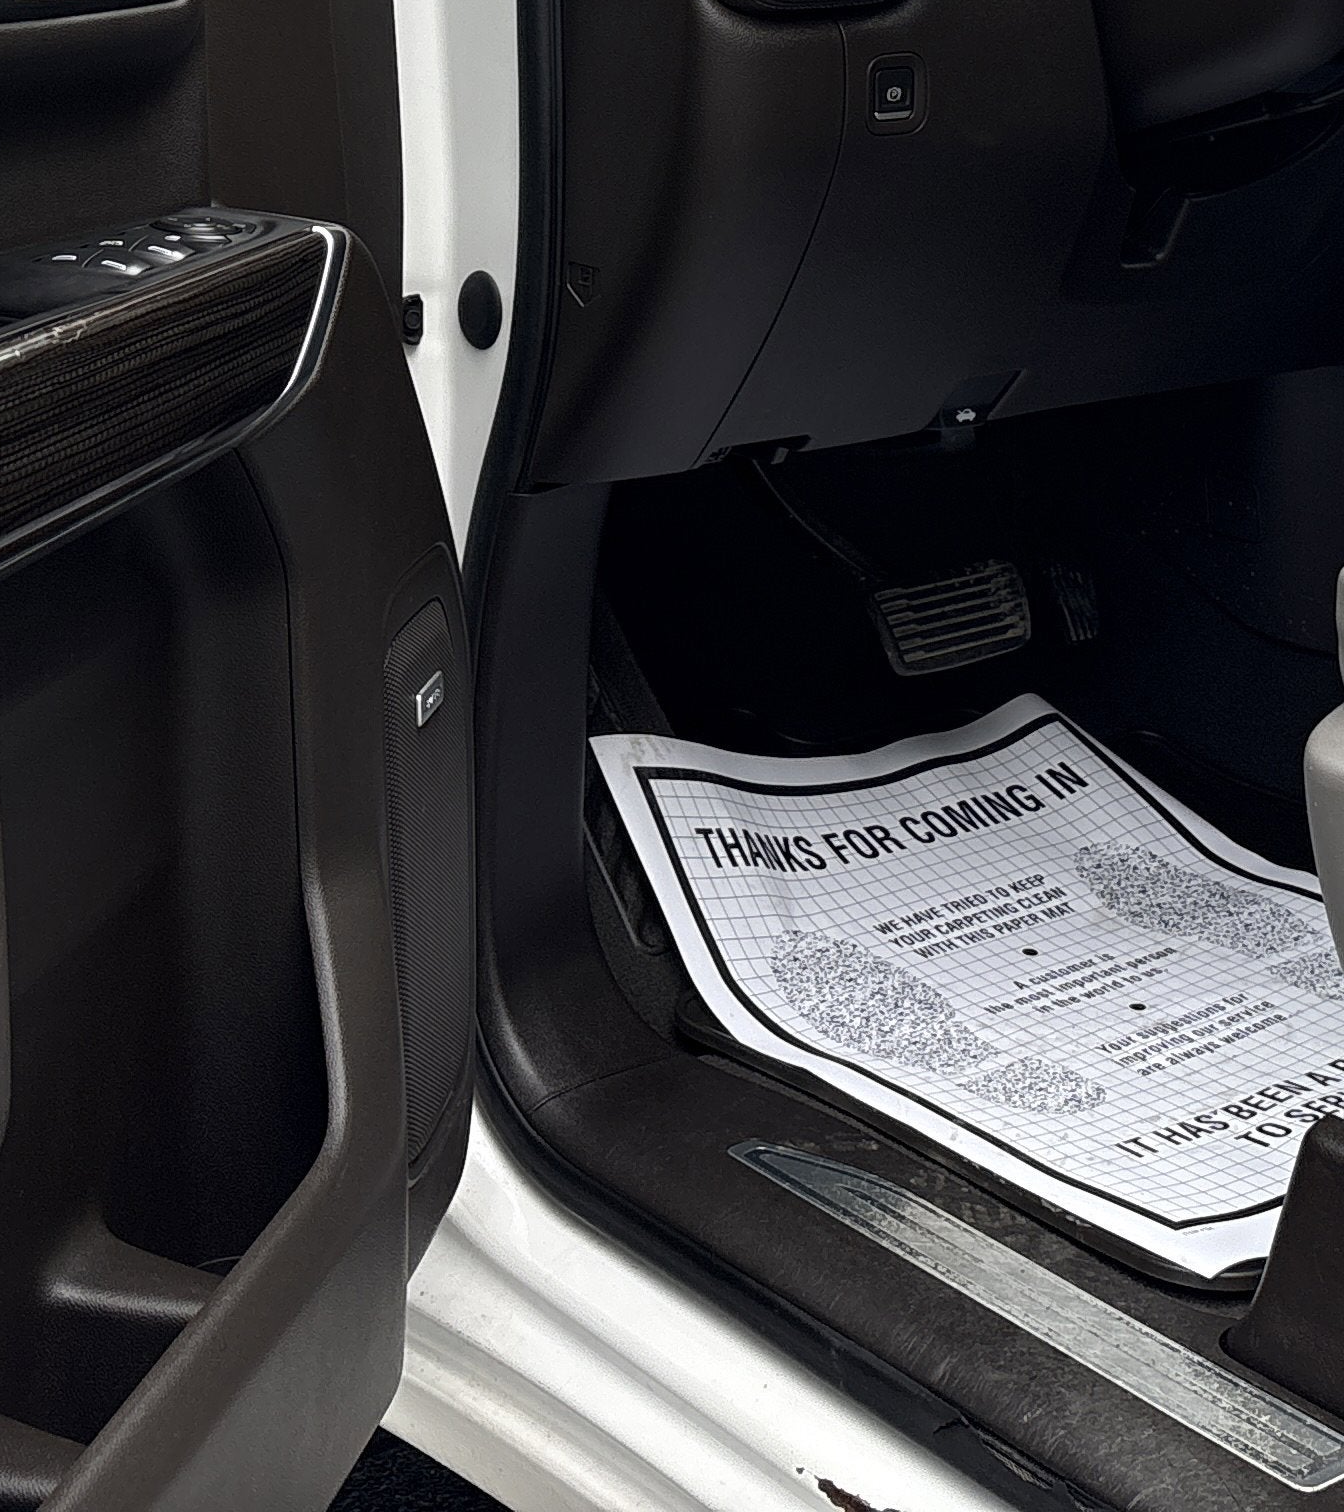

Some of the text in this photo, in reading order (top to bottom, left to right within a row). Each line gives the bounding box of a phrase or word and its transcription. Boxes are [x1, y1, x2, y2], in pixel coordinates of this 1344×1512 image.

[695, 761, 1090, 873] THANKS FOR COMING IN
[873, 873, 1046, 936] WE HAVE TRIED TO KEEP
[888, 886, 1068, 950] YOUR CARPETING CLEAN
[913, 901, 1077, 960] WITH THIS PAPER MAT
[983, 946, 1178, 1015] the most important person
[1013, 952, 1116, 991] A customer is
[1031, 1003, 1050, 1014] in
[1051, 994, 1082, 1008] the
[1079, 978, 1126, 1000] world
[1121, 974, 1143, 985] to
[1096, 991, 1250, 1054] Your suggestions for
[1191, 1022, 1220, 1039] our
[1218, 1000, 1275, 1028] service
[1136, 1061, 1167, 1077] are
[1164, 1039, 1222, 1066] always
[1114, 1136, 1160, 1159] IT
[1152, 1113, 1231, 1146] HAS
[1222, 1080, 1314, 1121] BEEN
[1304, 1071, 1342, 1087] A
[1233, 1122, 1293, 1149] TO
